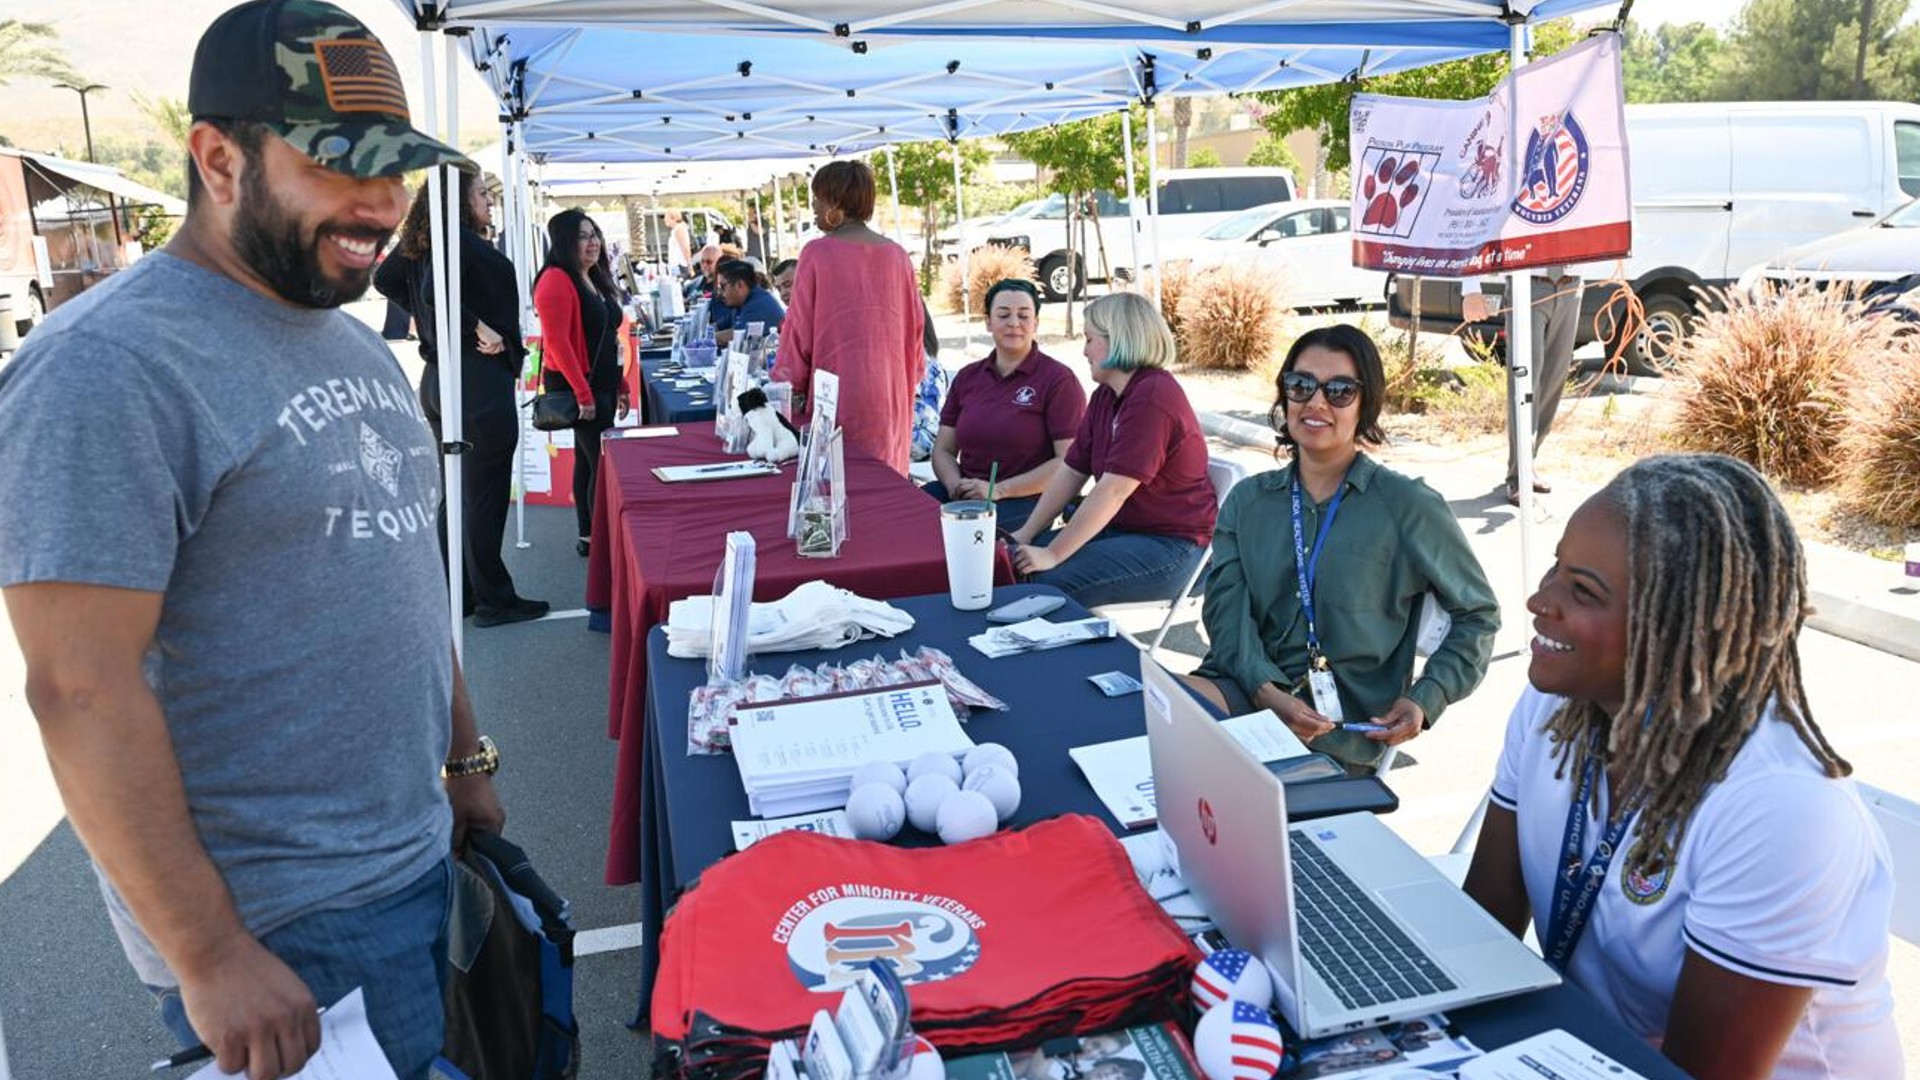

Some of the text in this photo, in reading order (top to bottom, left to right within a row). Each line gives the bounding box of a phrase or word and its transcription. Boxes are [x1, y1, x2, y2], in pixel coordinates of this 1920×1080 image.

[772, 883, 988, 945] CENTER FOR MINORITY VETERANS
[1133, 1028, 1164, 1064] HEALTH
